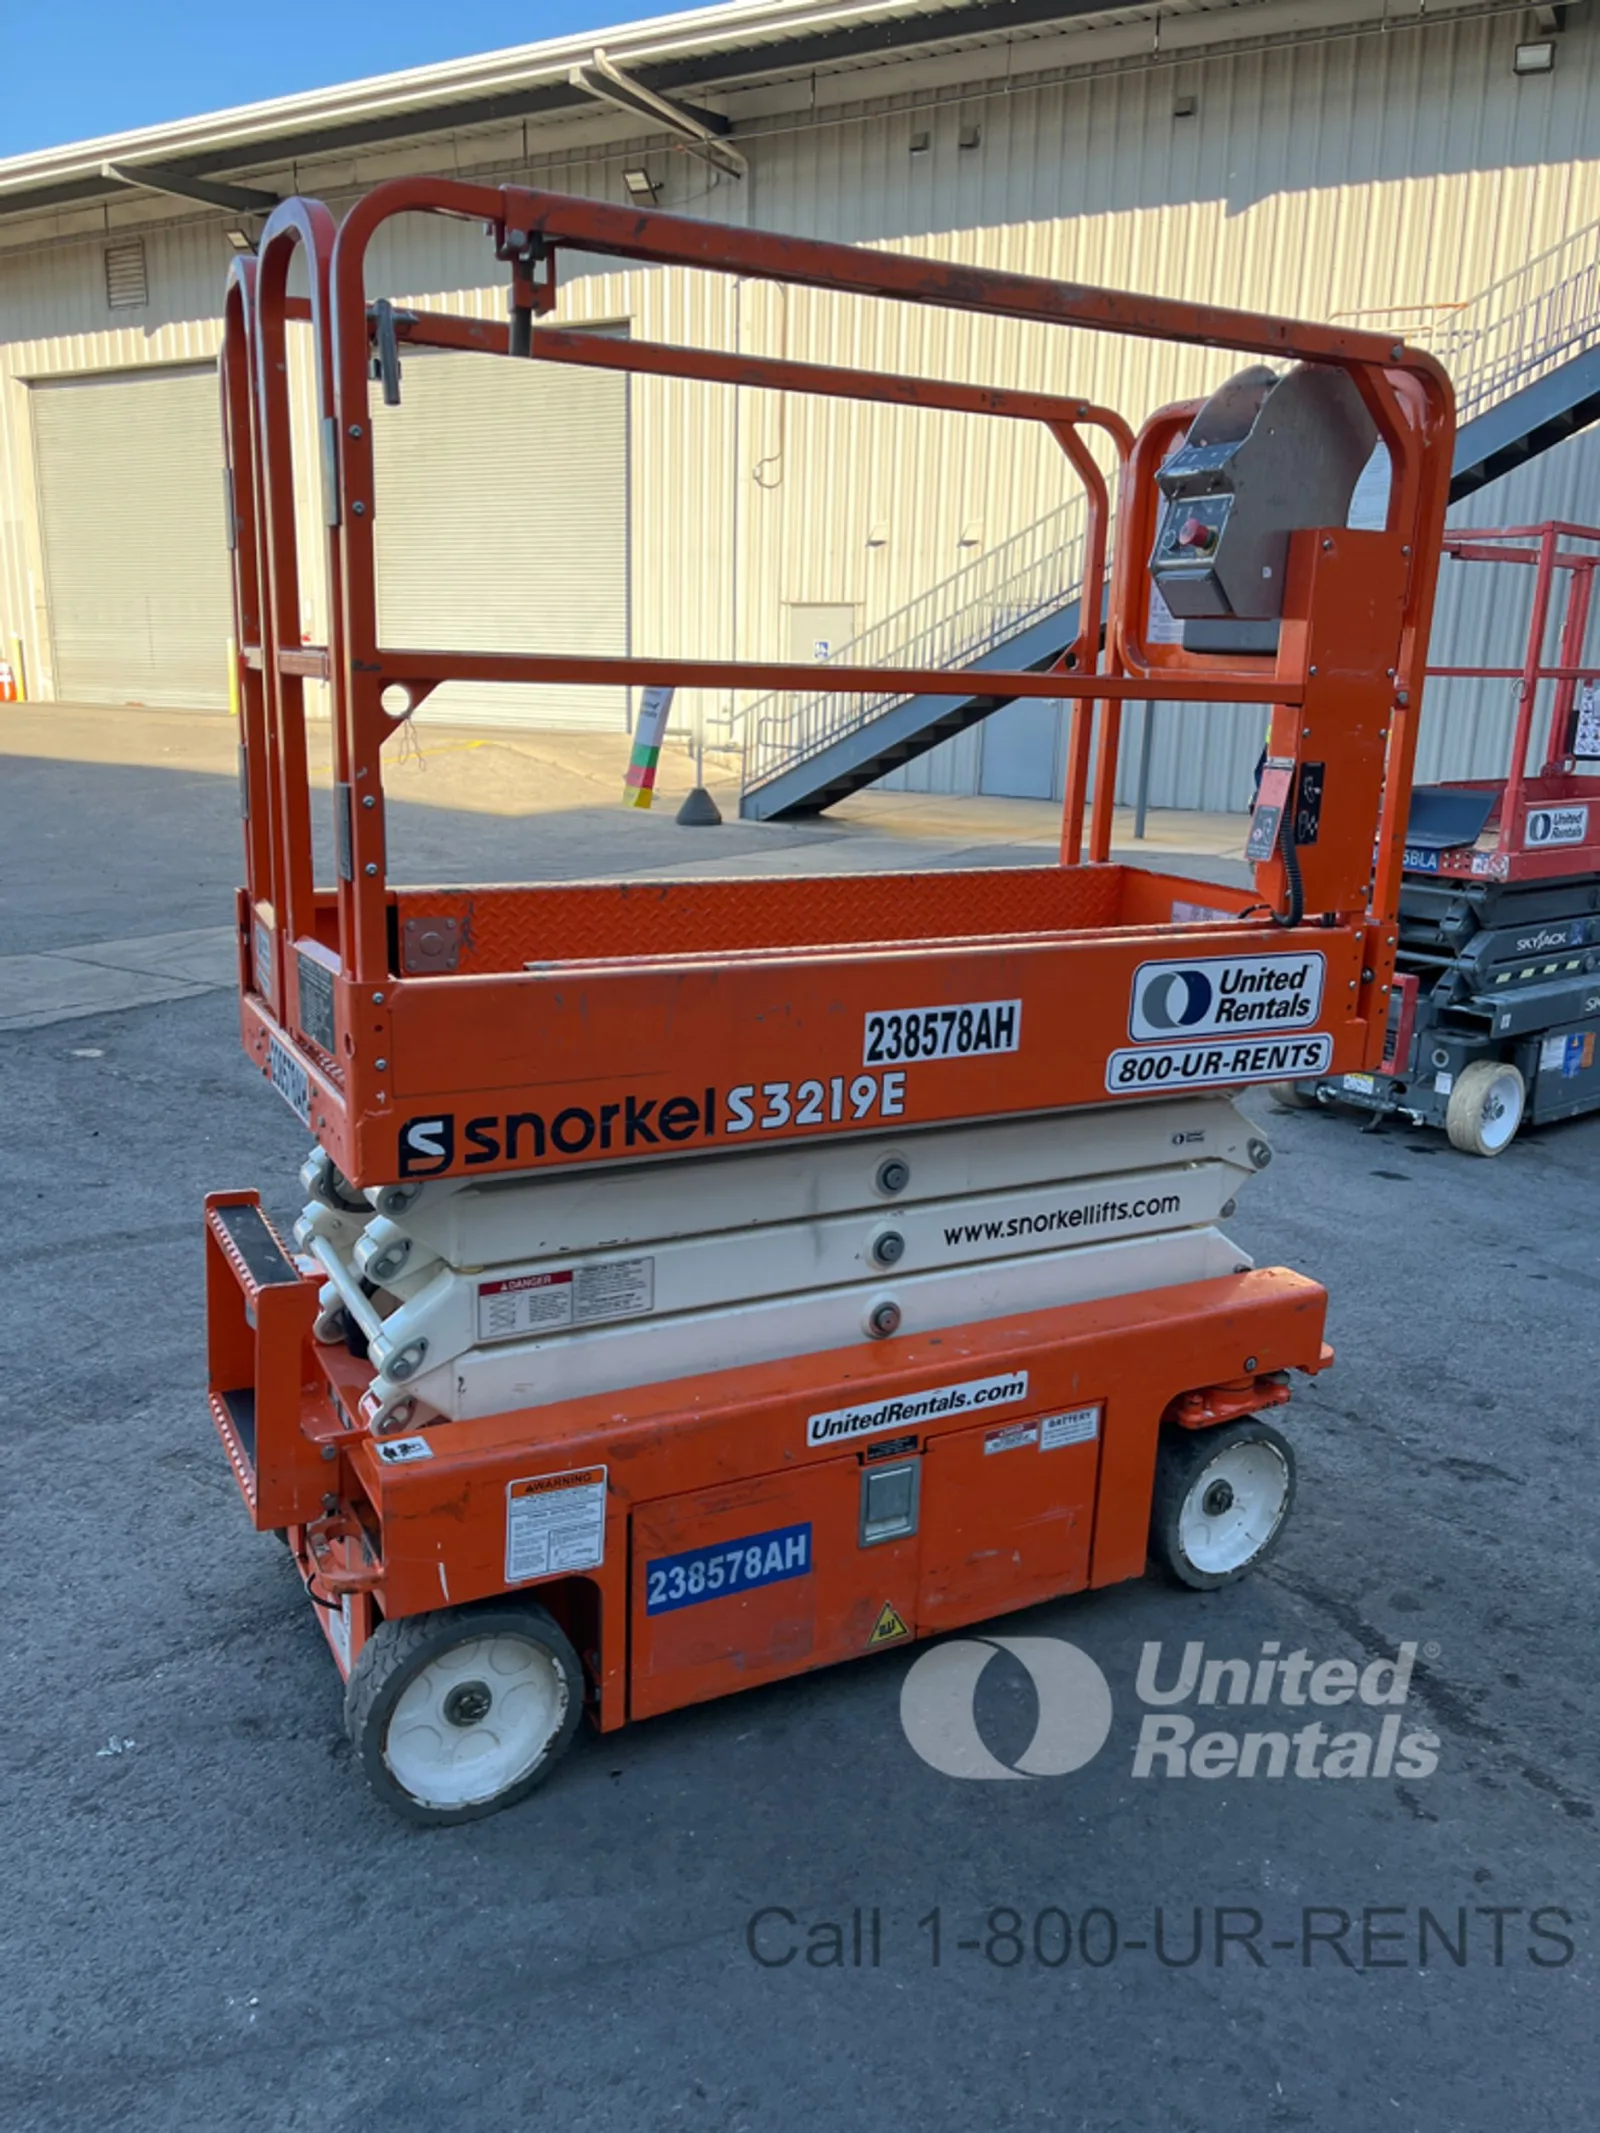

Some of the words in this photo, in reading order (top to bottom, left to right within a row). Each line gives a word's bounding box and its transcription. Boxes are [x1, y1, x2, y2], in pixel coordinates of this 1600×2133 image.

[1553, 811, 1583, 826] United
[1219, 965, 1309, 994] United
[1214, 993, 1311, 1023] Rentals
[866, 1005, 1015, 1061] 238578AH
[1118, 1043, 1322, 1082] 800-UR-RENTS
[464, 1087, 715, 1164] snorkel
[725, 1070, 906, 1133] S3219E
[943, 1195, 1180, 1246] www.snorkellifts.com
[508, 1275, 552, 1291] DANGER
[812, 1380, 1025, 1439] UnitedRentals.com
[535, 1473, 591, 1489] WARNING
[647, 1534, 806, 1605] 238578AH
